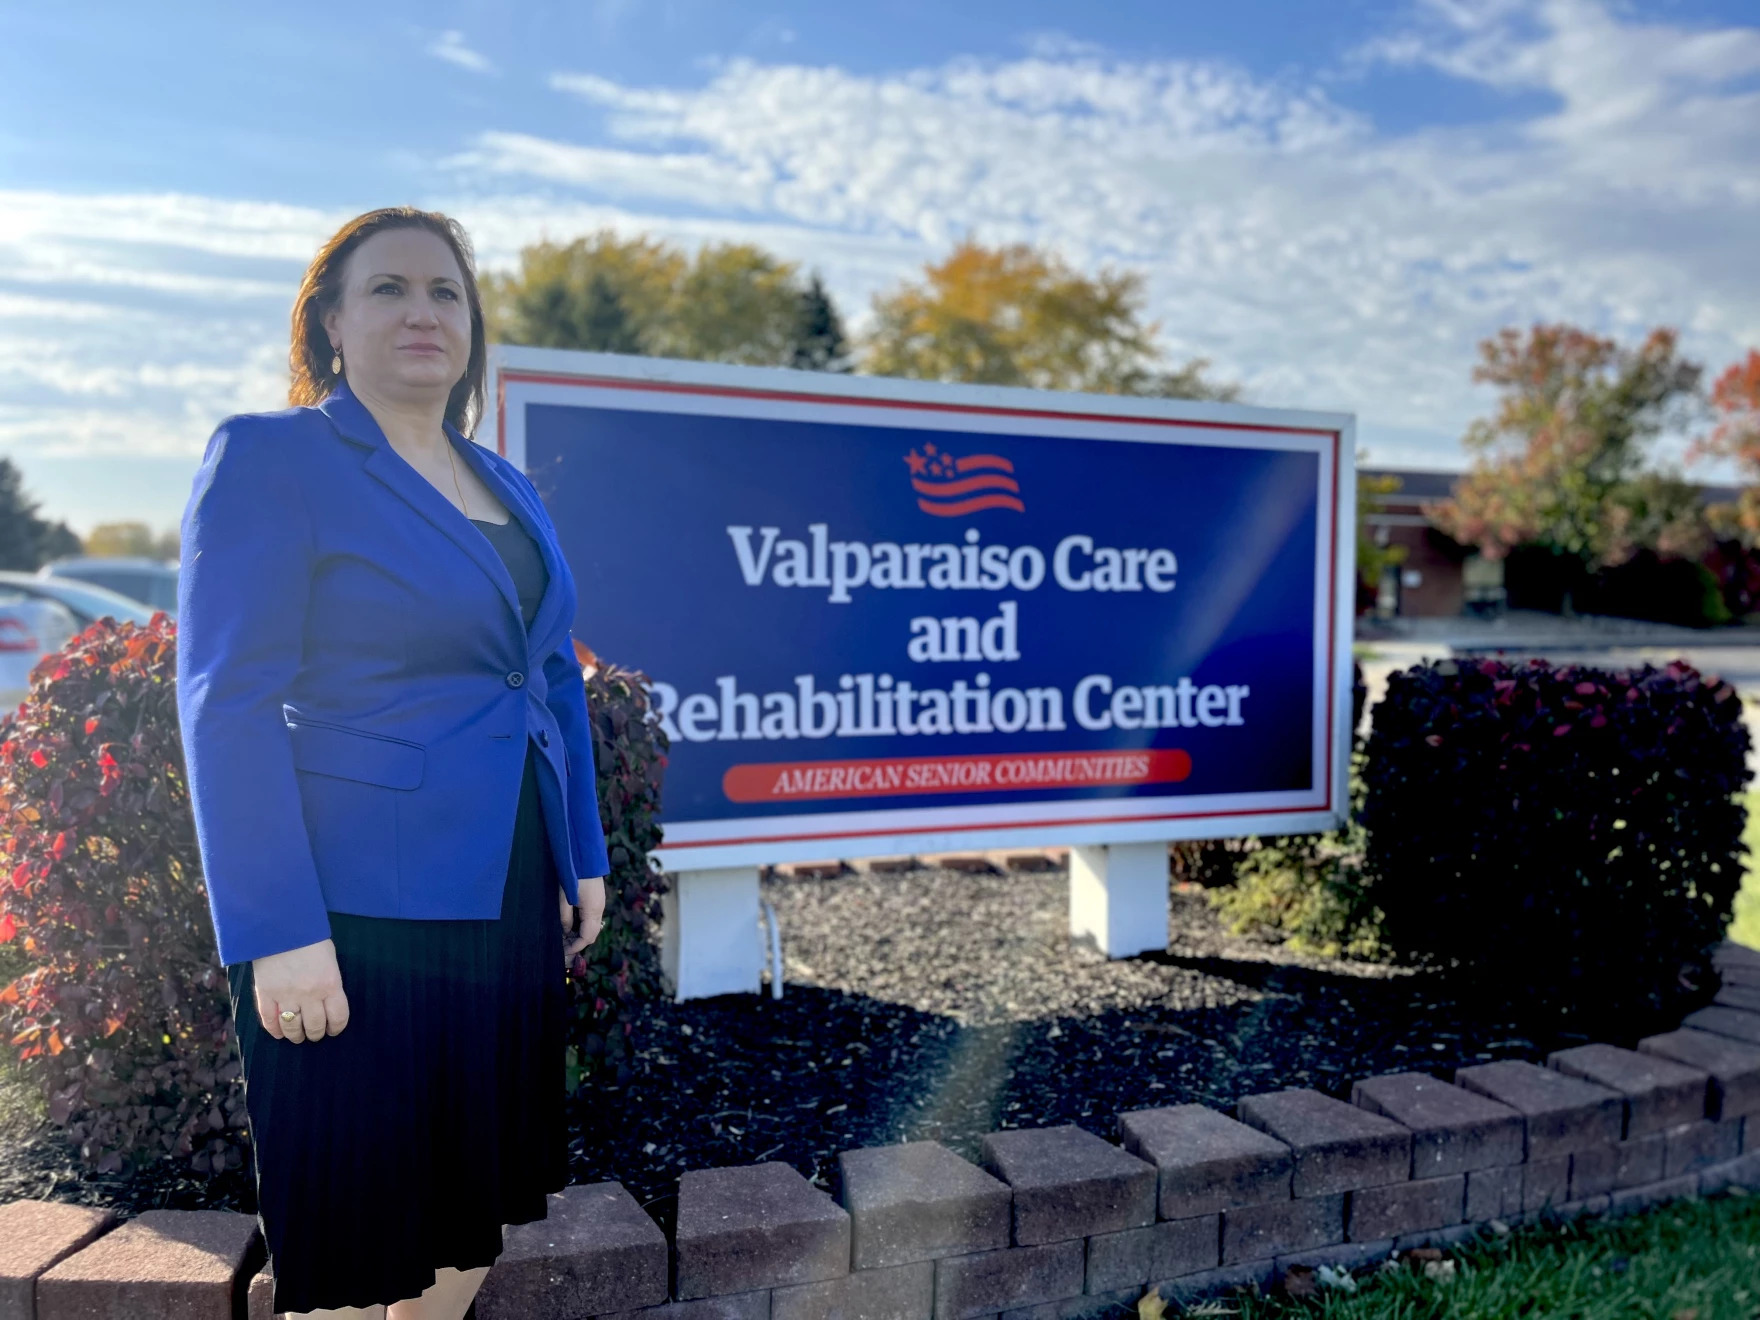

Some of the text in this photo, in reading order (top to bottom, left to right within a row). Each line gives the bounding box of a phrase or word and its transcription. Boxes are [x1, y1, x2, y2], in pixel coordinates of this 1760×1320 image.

[727, 523, 1178, 603] Valparaiso Care
[907, 602, 1020, 662] and
[644, 673, 1250, 743] Rehabilitation Center
[772, 755, 1151, 794] AMERICAN SENIOR COMMUNITIES
